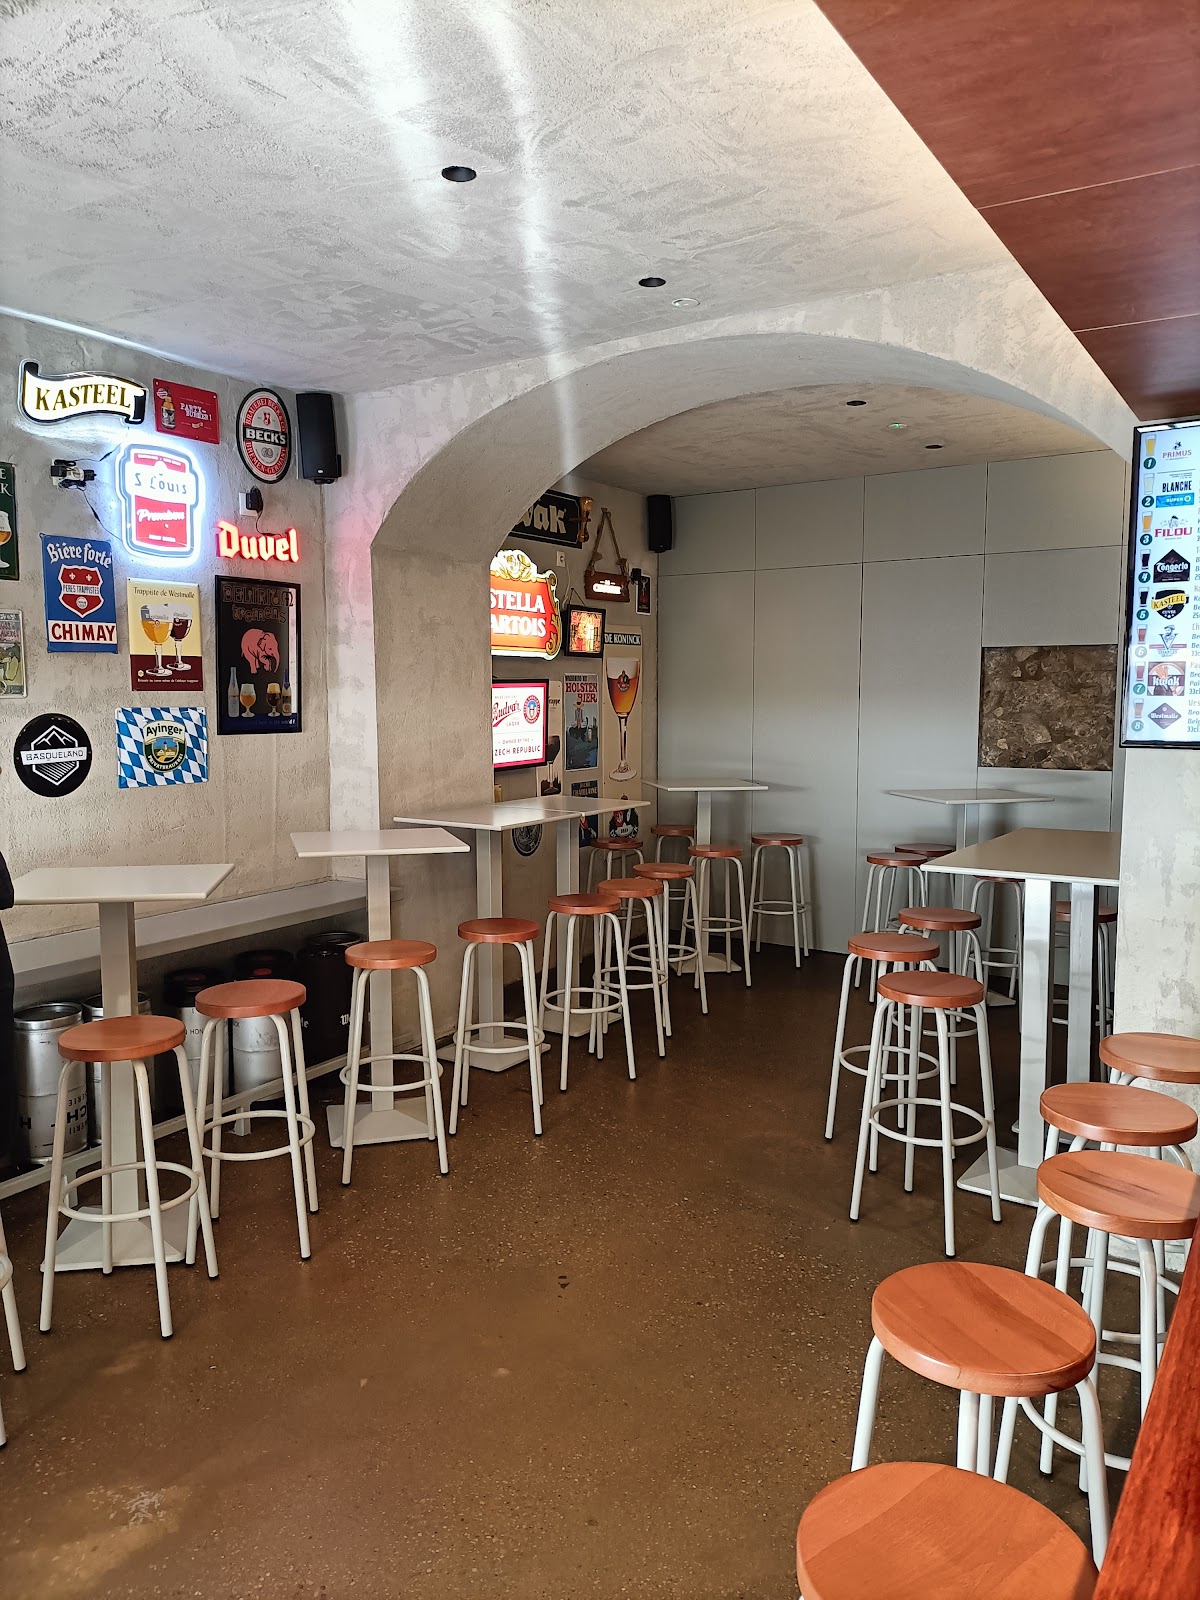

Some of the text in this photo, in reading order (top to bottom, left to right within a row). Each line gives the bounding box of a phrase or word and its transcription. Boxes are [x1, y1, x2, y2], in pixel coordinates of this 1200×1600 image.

[35, 383, 132, 411] KASTEEL
[245, 398, 267, 425] BRAUEREI
[245, 427, 287, 445] BECK'S
[1162, 449, 1192, 458] PRIMUS
[1162, 480, 1192, 493] BLANCHE
[1154, 527, 1192, 538] FILOU
[217, 520, 299, 563] Duvel
[1156, 561, 1188, 572] Tongerlo
[134, 586, 158, 597] Trappiste
[168, 590, 195, 599] Westmalle
[222, 586, 294, 607] DELIRIUM
[490, 588, 546, 614] STELLA
[1153, 594, 1186, 610] KASTEEL
[52, 622, 116, 642] CHIMAY
[490, 614, 547, 638] ARTOIS
[604, 633, 641, 645] DE KONINCK
[566, 682, 598, 692] HOLSTEN
[578, 692, 598, 703] BIER
[146, 724, 183, 736] Ayinger
[26, 750, 84, 762] BASQUELAND
[512, 745, 540, 754] REPUBLIC
[147, 753, 184, 770] PRIVATBRAUEREI
